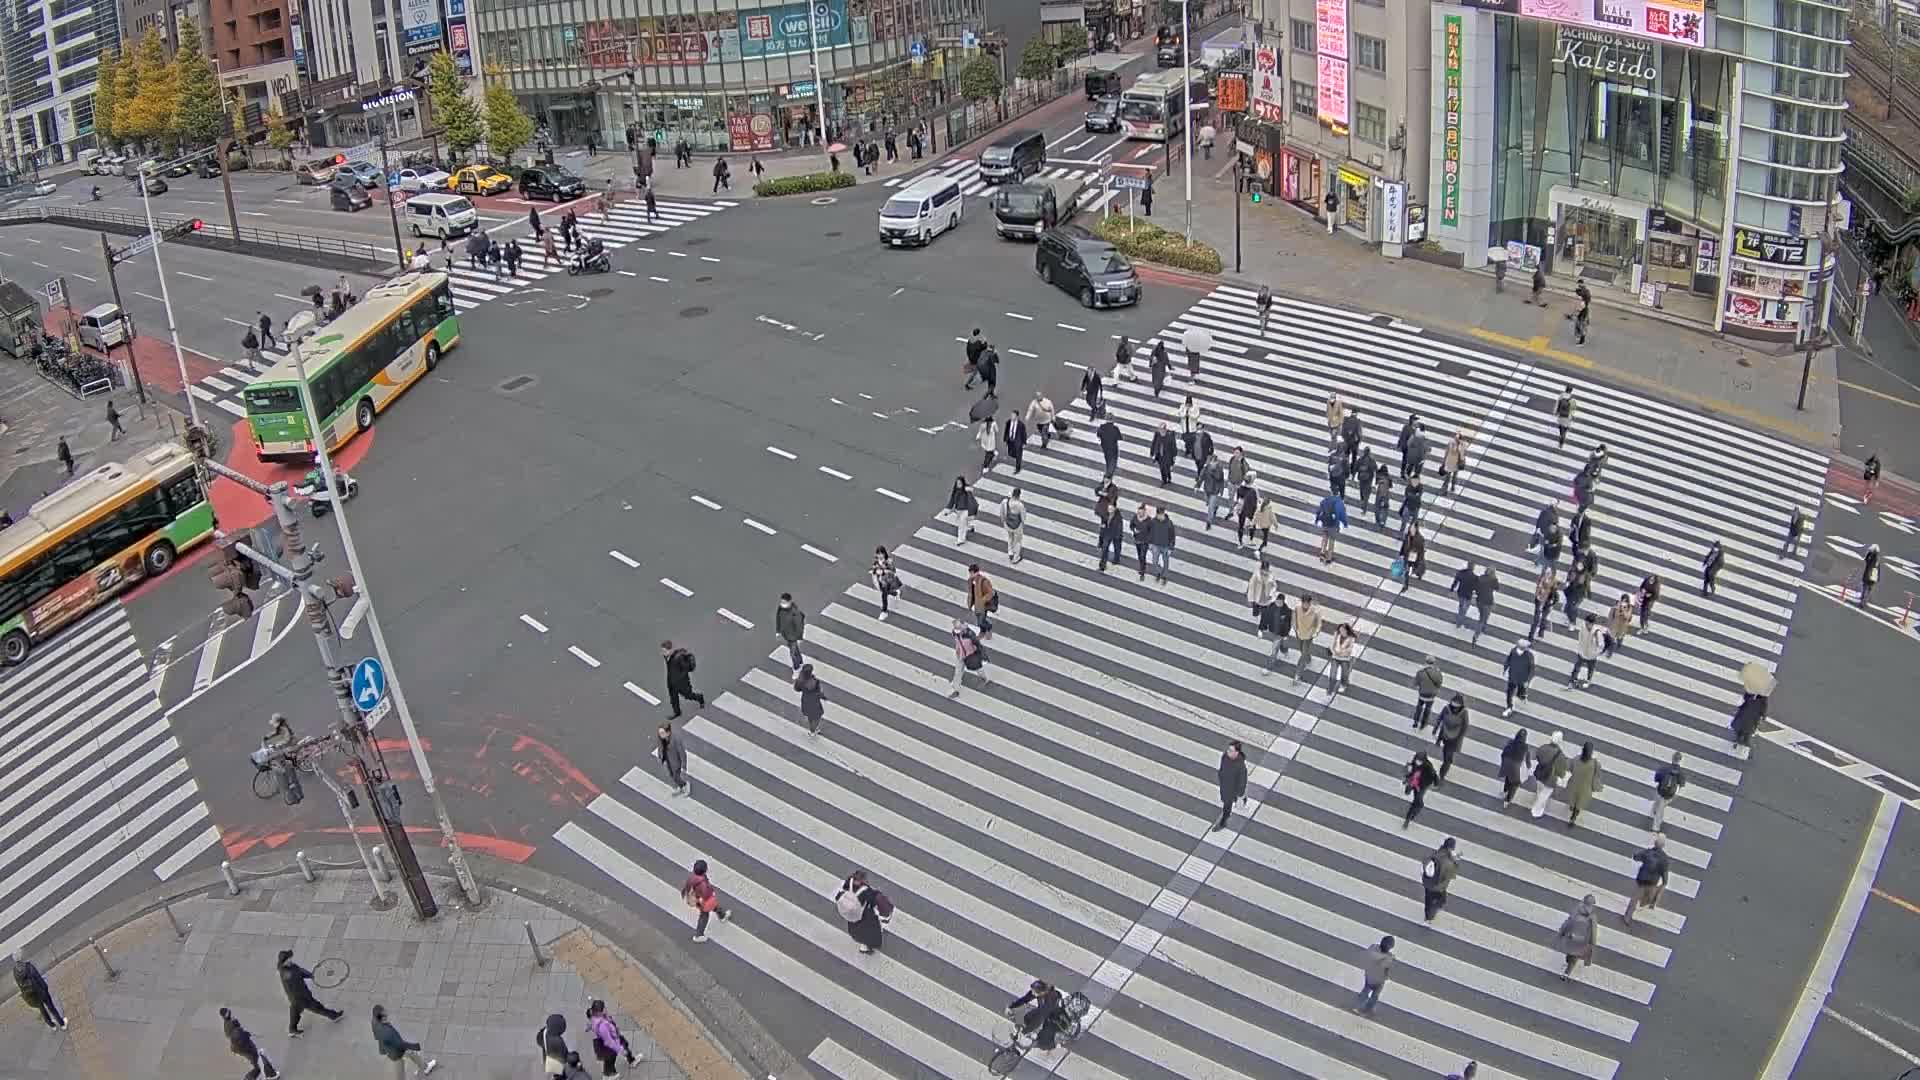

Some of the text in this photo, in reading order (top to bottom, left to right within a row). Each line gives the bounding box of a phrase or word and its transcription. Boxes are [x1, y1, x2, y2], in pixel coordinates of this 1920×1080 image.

[1557, 26, 1613, 45] PACHINKO
[1625, 39, 1651, 52] SLOT
[1551, 39, 1657, 80] Kaleido
[1747, 238, 1760, 248] 7F
